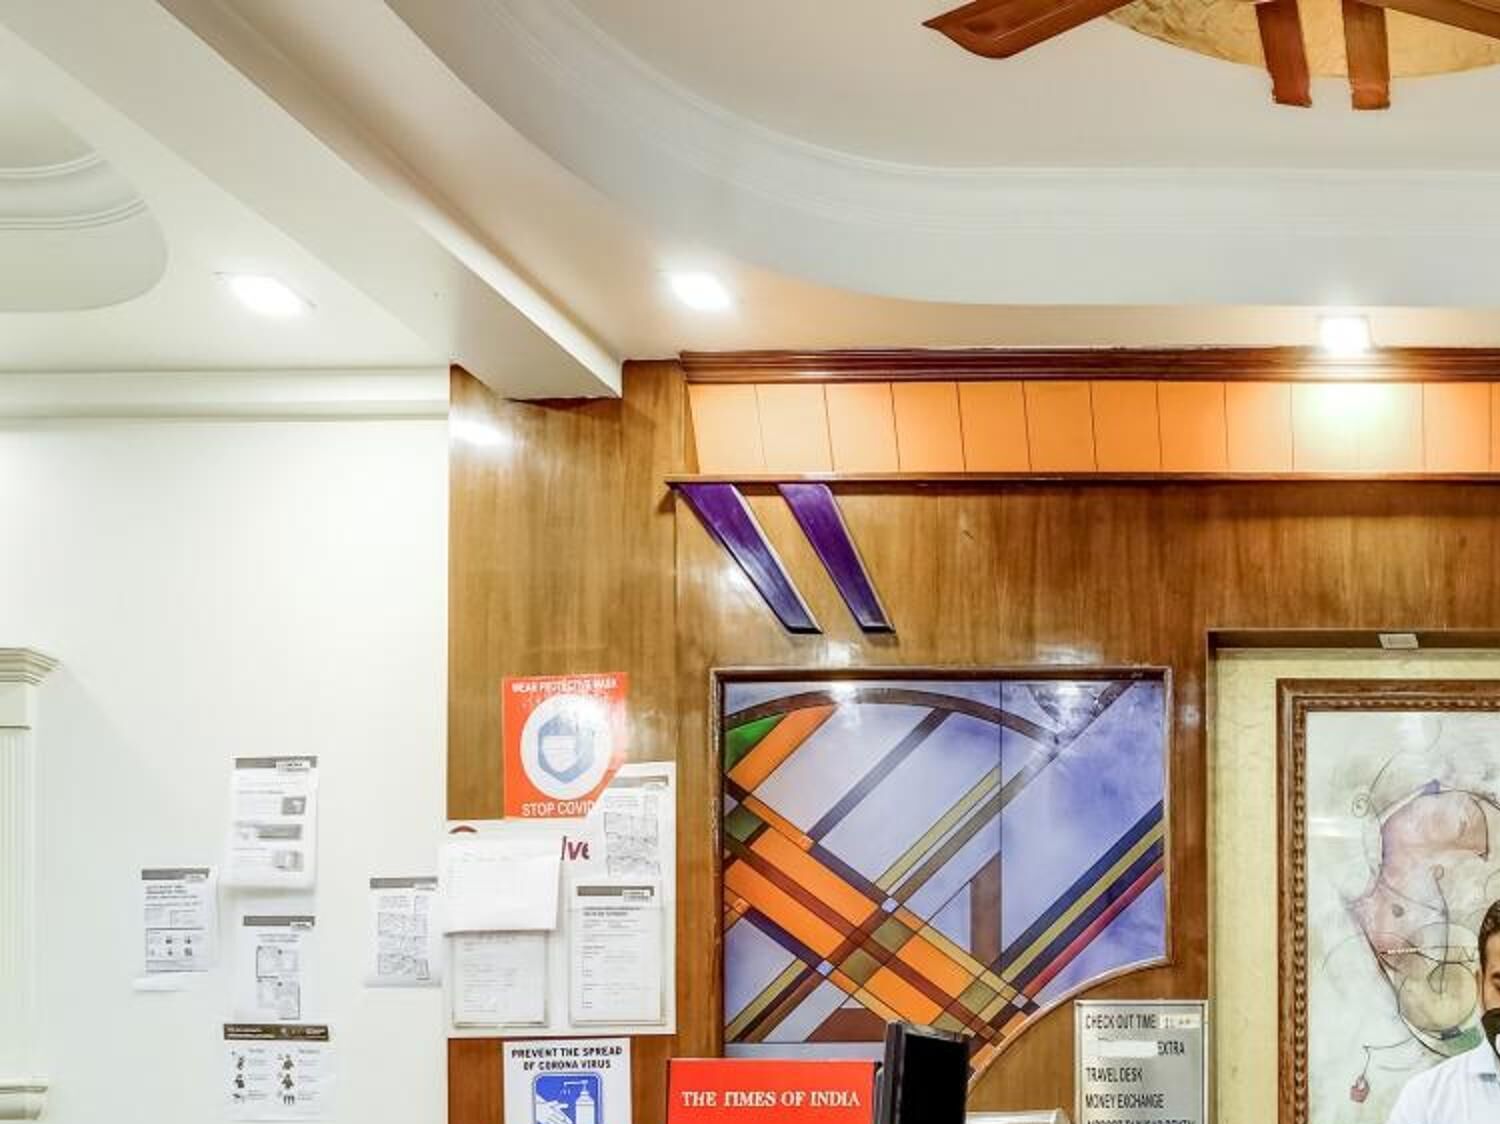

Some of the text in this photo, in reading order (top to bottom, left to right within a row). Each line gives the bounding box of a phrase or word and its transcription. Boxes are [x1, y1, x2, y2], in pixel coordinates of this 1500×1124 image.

[522, 801, 555, 817] STOP
[1085, 1014, 1116, 1029] CHECK
[1117, 1014, 1134, 1029] OUT
[511, 1046, 623, 1059] PREVENT THE SPREAD
[1157, 1041, 1185, 1056] EXTRA
[523, 1059, 611, 1071] OF CORONA VIRUS
[1085, 1067, 1143, 1082] TRAVEL DESK
[682, 1091, 861, 1107] THE TIMES OF INDIA
[1085, 1094, 1164, 1109] MONEY EXCHANGE
